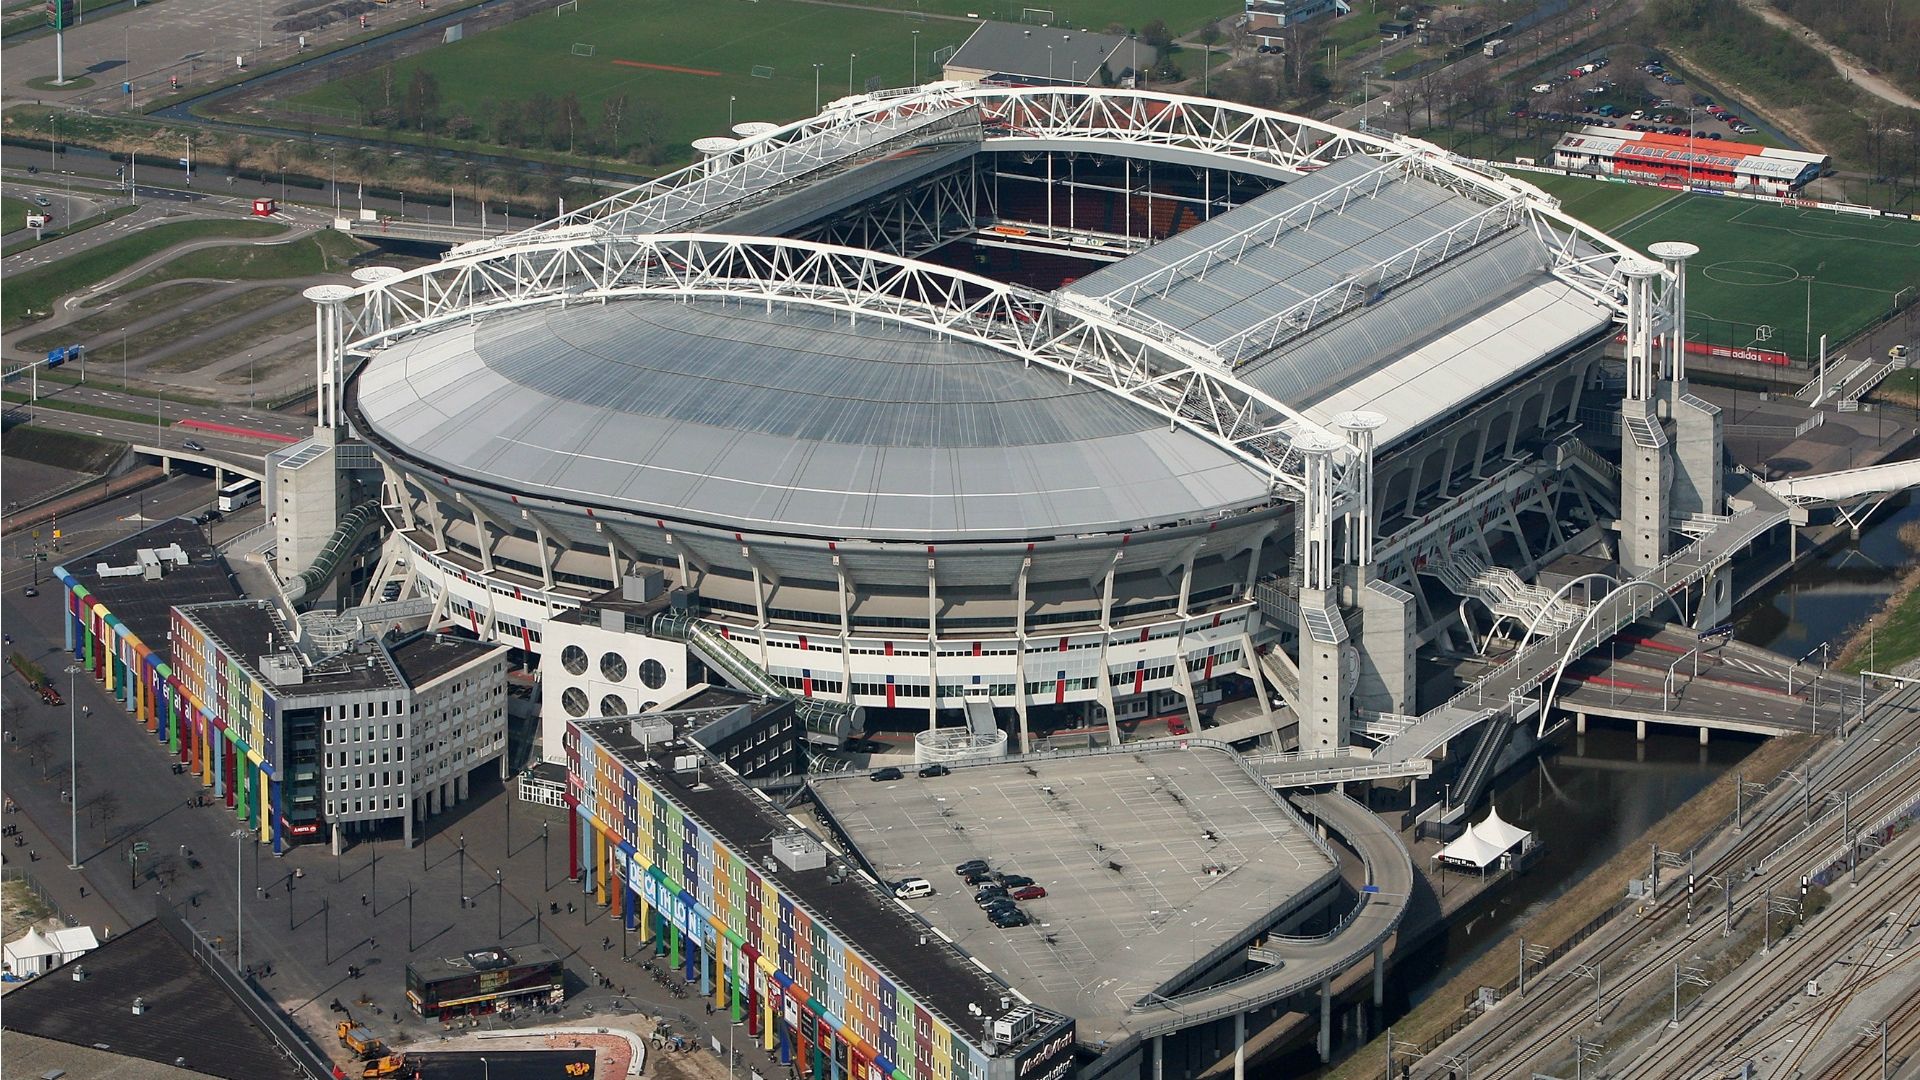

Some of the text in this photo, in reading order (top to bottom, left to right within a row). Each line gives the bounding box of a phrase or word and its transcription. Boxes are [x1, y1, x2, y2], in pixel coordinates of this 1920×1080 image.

[1587, 141, 1780, 173] AFC AJAX AMSTERDAM
[1732, 350, 1762, 362] adidas
